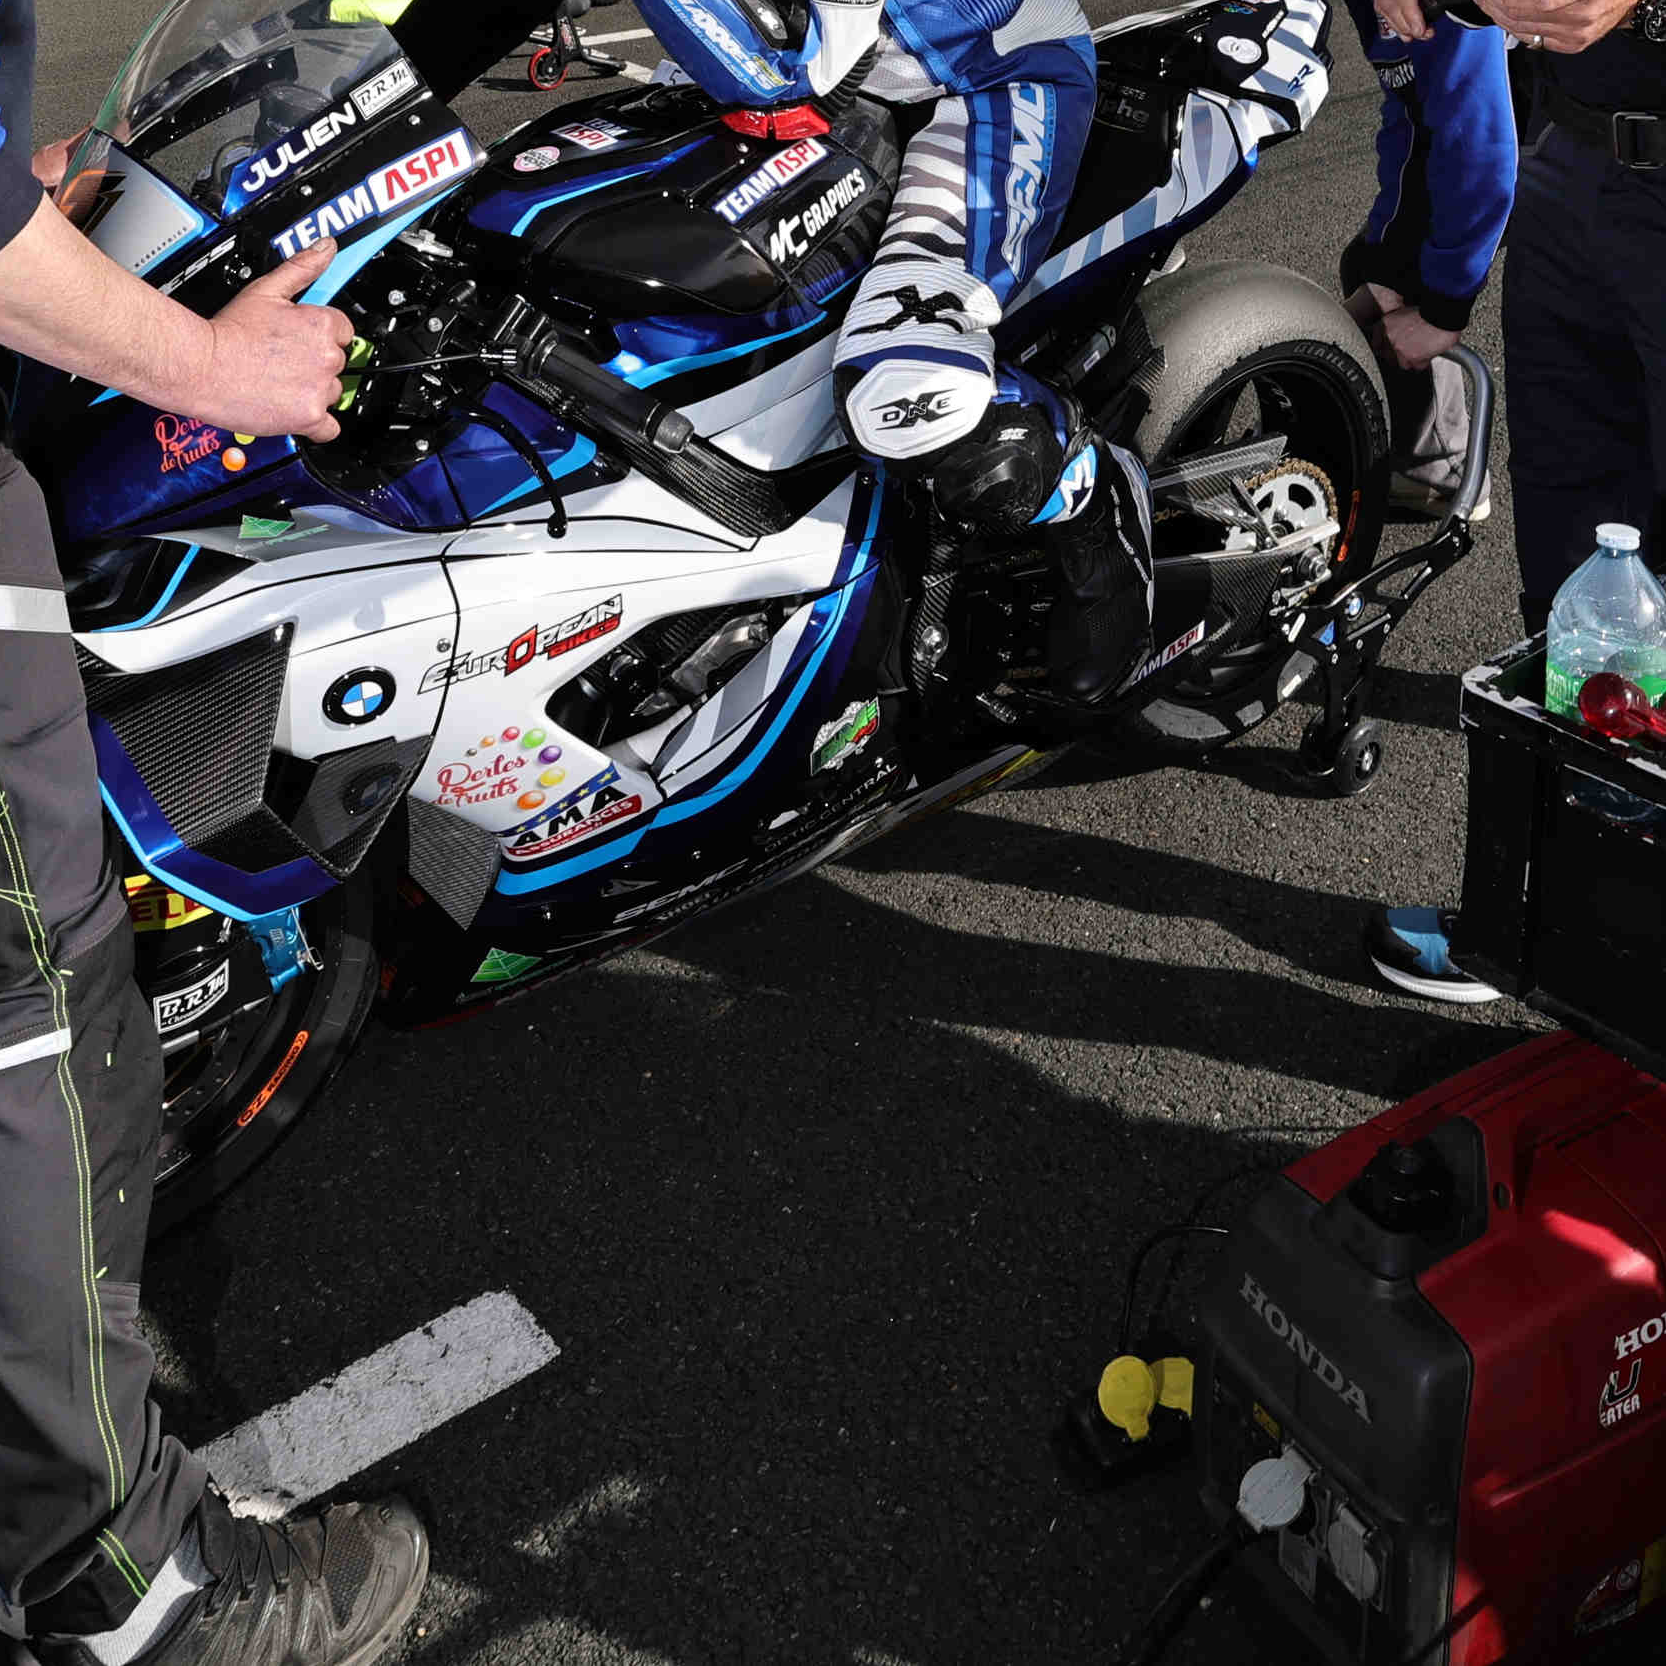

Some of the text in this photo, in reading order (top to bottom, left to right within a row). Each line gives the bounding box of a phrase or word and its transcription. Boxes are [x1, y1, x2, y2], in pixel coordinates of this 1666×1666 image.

[242, 101, 357, 192] JULIEN
[714, 140, 819, 222] TEAM ASPI
[274, 141, 460, 259] TEAM ASPI
[801, 168, 867, 238] GRAPHICS
[437, 753, 528, 793] Perles
[513, 786, 629, 847] AMA
[161, 972, 226, 1020] B.R.M
[1239, 1271, 1374, 1424] HONDA
